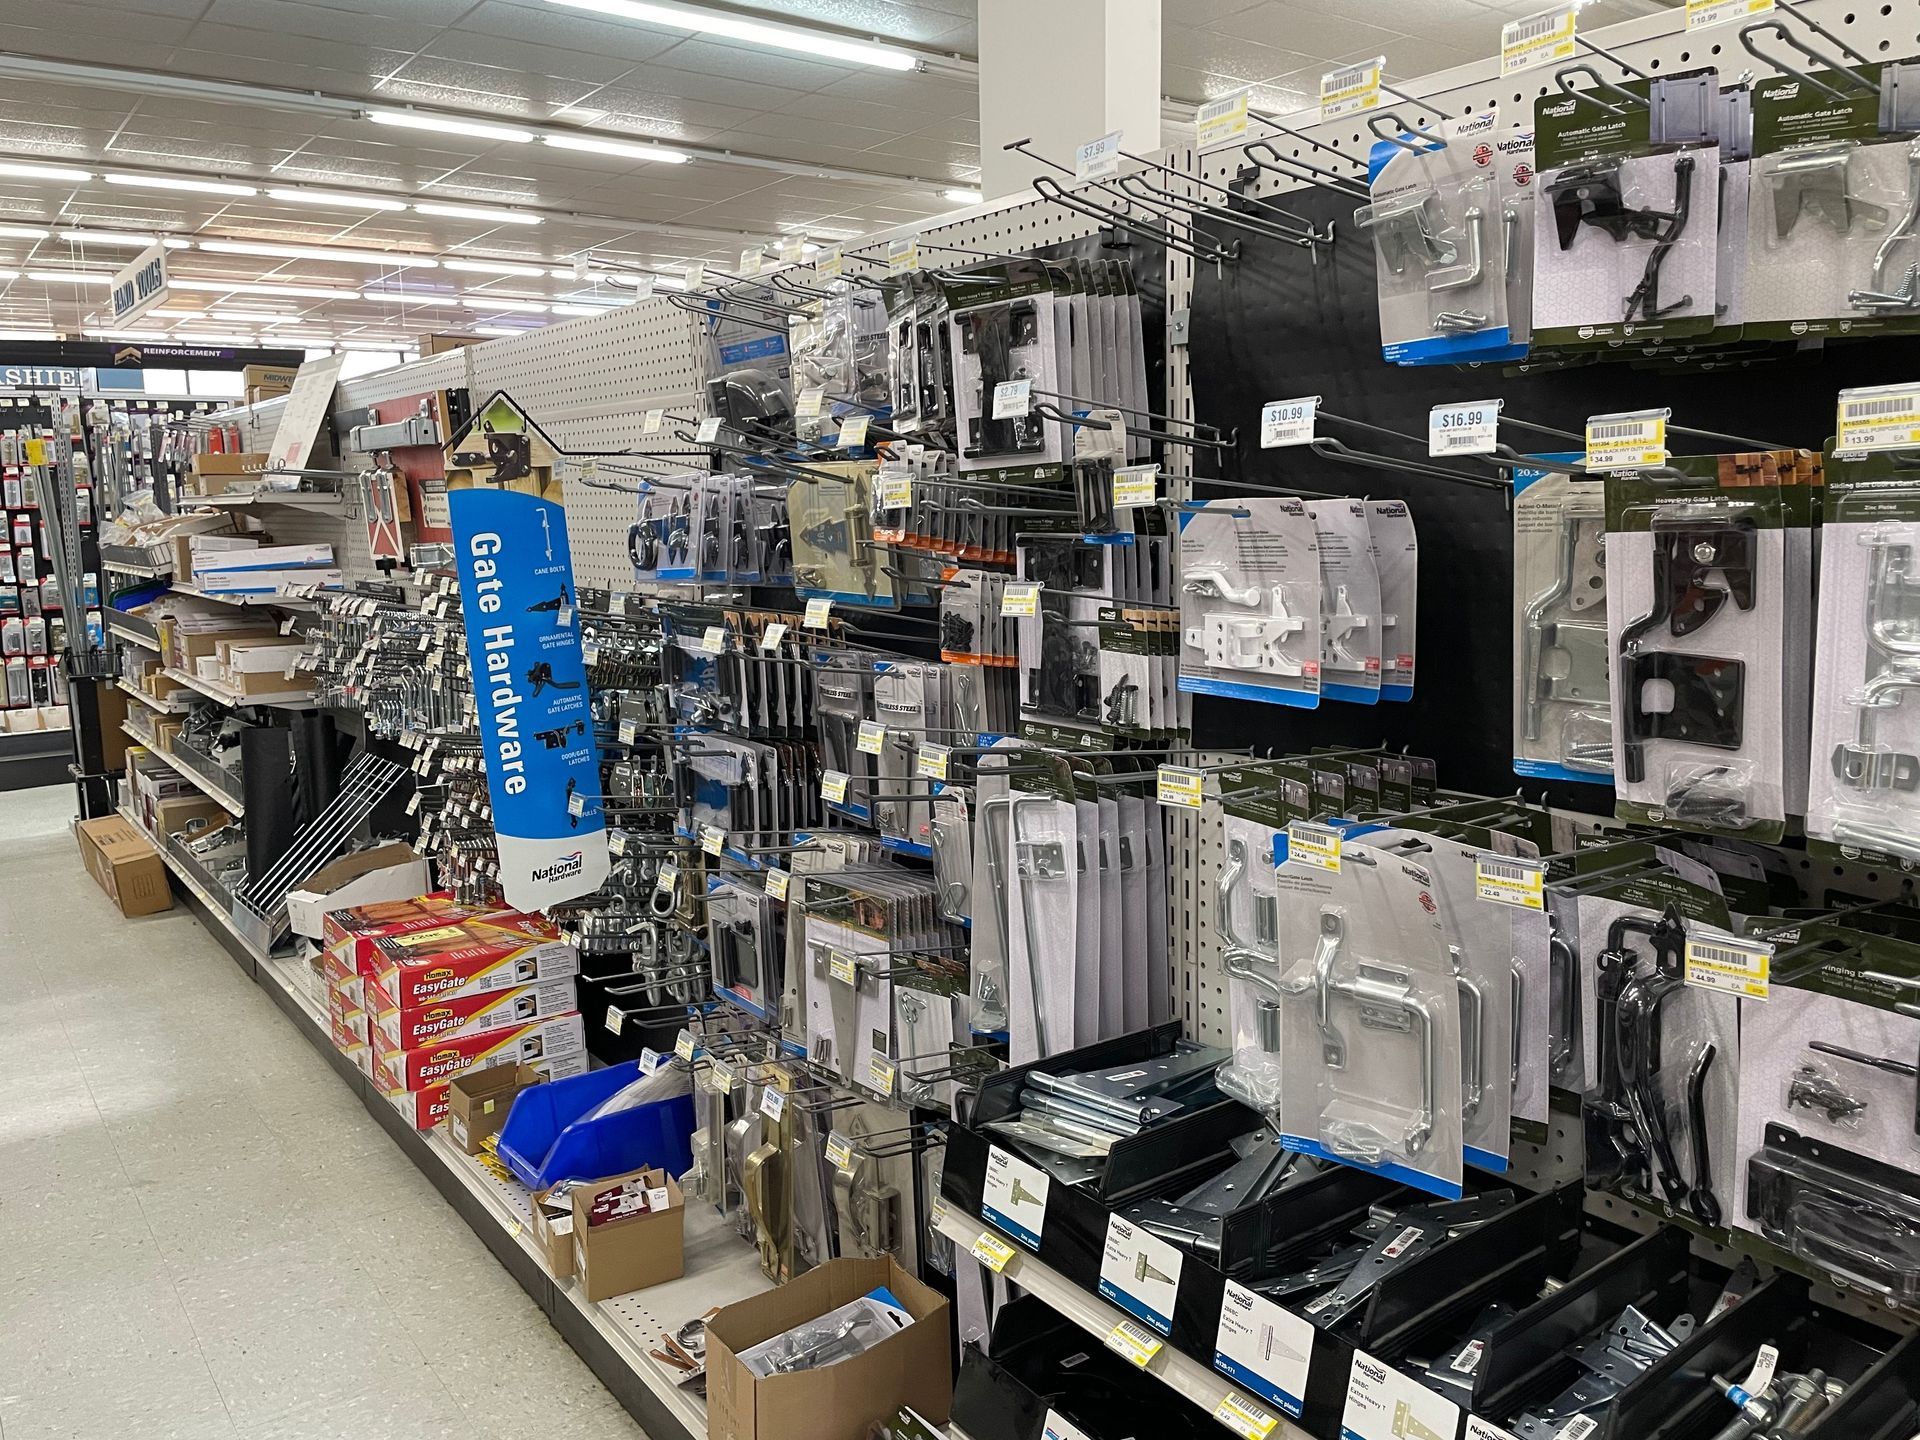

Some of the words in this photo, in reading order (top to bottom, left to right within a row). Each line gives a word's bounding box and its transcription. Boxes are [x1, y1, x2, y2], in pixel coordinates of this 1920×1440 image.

[1510, 57, 1527, 67] 10.99
[1763, 85, 1800, 98] National
[1542, 102, 1576, 115] National
[1777, 112, 1813, 122] Automatic
[1814, 110, 1832, 118] Gate
[1832, 107, 1853, 115] Latch
[1456, 115, 1495, 135] National
[1557, 124, 1592, 138] Automatic
[1591, 123, 1606, 133] Gate
[1607, 121, 1627, 132] Latch
[1083, 142, 1105, 159] $7.99
[113, 280, 135, 316] HAND
[135, 257, 162, 299] TOOLS
[143, 347, 222, 358] REINFORCEMENT
[0, 368, 83, 387] SHIE
[263, 373, 297, 385] MIDWE
[1271, 406, 1303, 422] $10.99
[1442, 411, 1483, 428] $16.99
[1851, 435, 1875, 444] 13.99
[1595, 455, 1613, 463] 34.99
[1610, 470, 1638, 478] Nation
[1280, 505, 1303, 514] National
[1376, 506, 1406, 515] National
[470, 532, 504, 614] Gate
[534, 566, 550, 576] CANE
[549, 565, 566, 574] BOLTS
[538, 631, 574, 643] ORNAMENTAL
[542, 641, 556, 650] GATE
[556, 638, 575, 648] HINGES
[553, 694, 583, 706] AUTOMATIC
[483, 625, 527, 796] Hardware
[547, 705, 562, 715] GATE
[561, 701, 583, 712] LATCHES
[899, 704, 917, 712] STEEL
[561, 749, 590, 761] DOOR/GATE
[568, 755, 590, 766] LATCHES
[532, 854, 582, 882] National
[548, 867, 582, 883] Hardware
[1402, 867, 1430, 884] National
[1672, 884, 1688, 894] Latch
[425, 969, 452, 980] Homax
[1705, 969, 1720, 977] BLACK
[1820, 963, 1856, 978] winging
[413, 976, 467, 995] EasyGate
[1696, 973, 1716, 984] 44.99
[425, 1009, 452, 1020] Homax
[413, 1016, 466, 1036] EasyGate
[432, 1051, 458, 1062] Homax
[420, 1057, 473, 1078] EasyGate
[990, 1151, 1008, 1168] National
[986, 1180, 998, 1189] Hinges
[996, 1176, 1005, 1187] Heavy
[1110, 1220, 1132, 1239] National
[1105, 1251, 1118, 1263] Hinges
[1106, 1243, 1117, 1254] Extra
[1117, 1249, 1128, 1262] Heavy
[1226, 1288, 1254, 1308] National
[1233, 1299, 1251, 1312] Hardware
[1146, 1314, 1156, 1324] Zinc
[1155, 1319, 1169, 1332] plated
[1221, 1321, 1238, 1335] Hinges
[1222, 1314, 1234, 1327] Extra
[1235, 1320, 1250, 1334] Heavy
[1354, 1359, 1387, 1382] National
[1362, 1370, 1385, 1385] Hardware
[1351, 1376, 1369, 1391] 286BC
[1272, 1393, 1284, 1406] Zinc
[1283, 1400, 1300, 1415] plated
[1348, 1394, 1367, 1411] Hinges
[1350, 1386, 1364, 1400] Extra
[1364, 1394, 1382, 1410] Heavy
